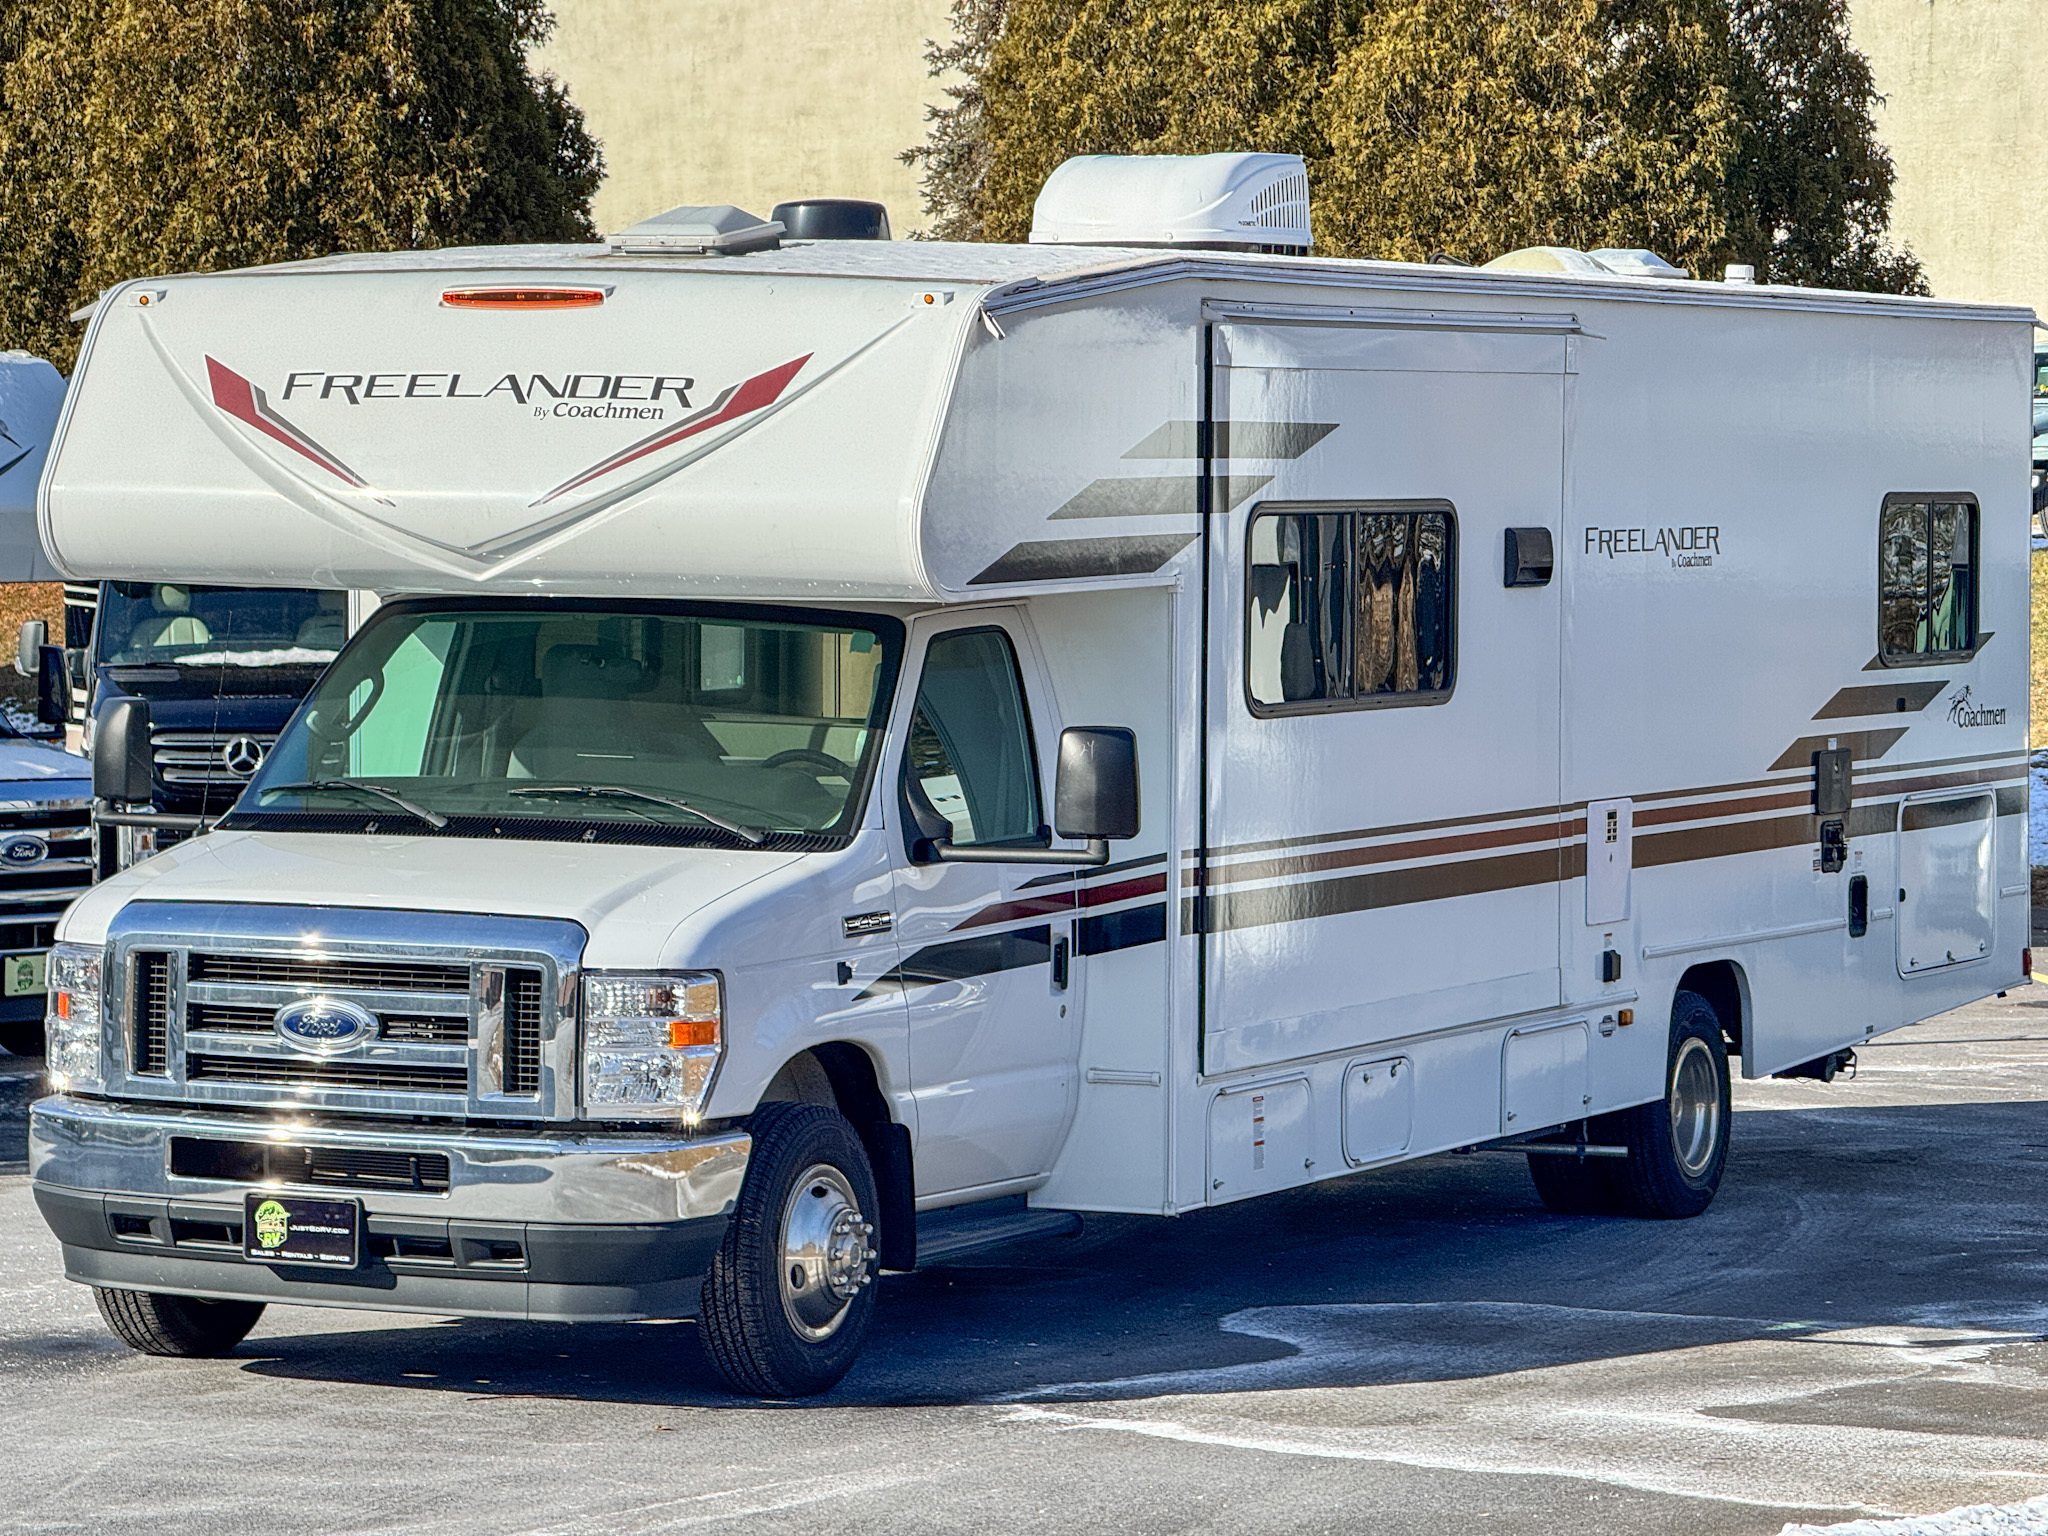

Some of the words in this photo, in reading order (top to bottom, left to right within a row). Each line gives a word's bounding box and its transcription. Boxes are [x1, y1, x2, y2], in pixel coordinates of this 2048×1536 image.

[282, 372, 695, 408] FREELANDER
[533, 406, 549, 420] By
[553, 402, 664, 420] Coachmen
[1585, 526, 1720, 560] FREELANDER
[1677, 552, 1713, 568] Coachmen
[1958, 703, 2006, 728] Coachmen
[12, 844, 36, 858] Ford
[298, 1011, 342, 1035] Ford
[263, 1232, 281, 1247] RV
